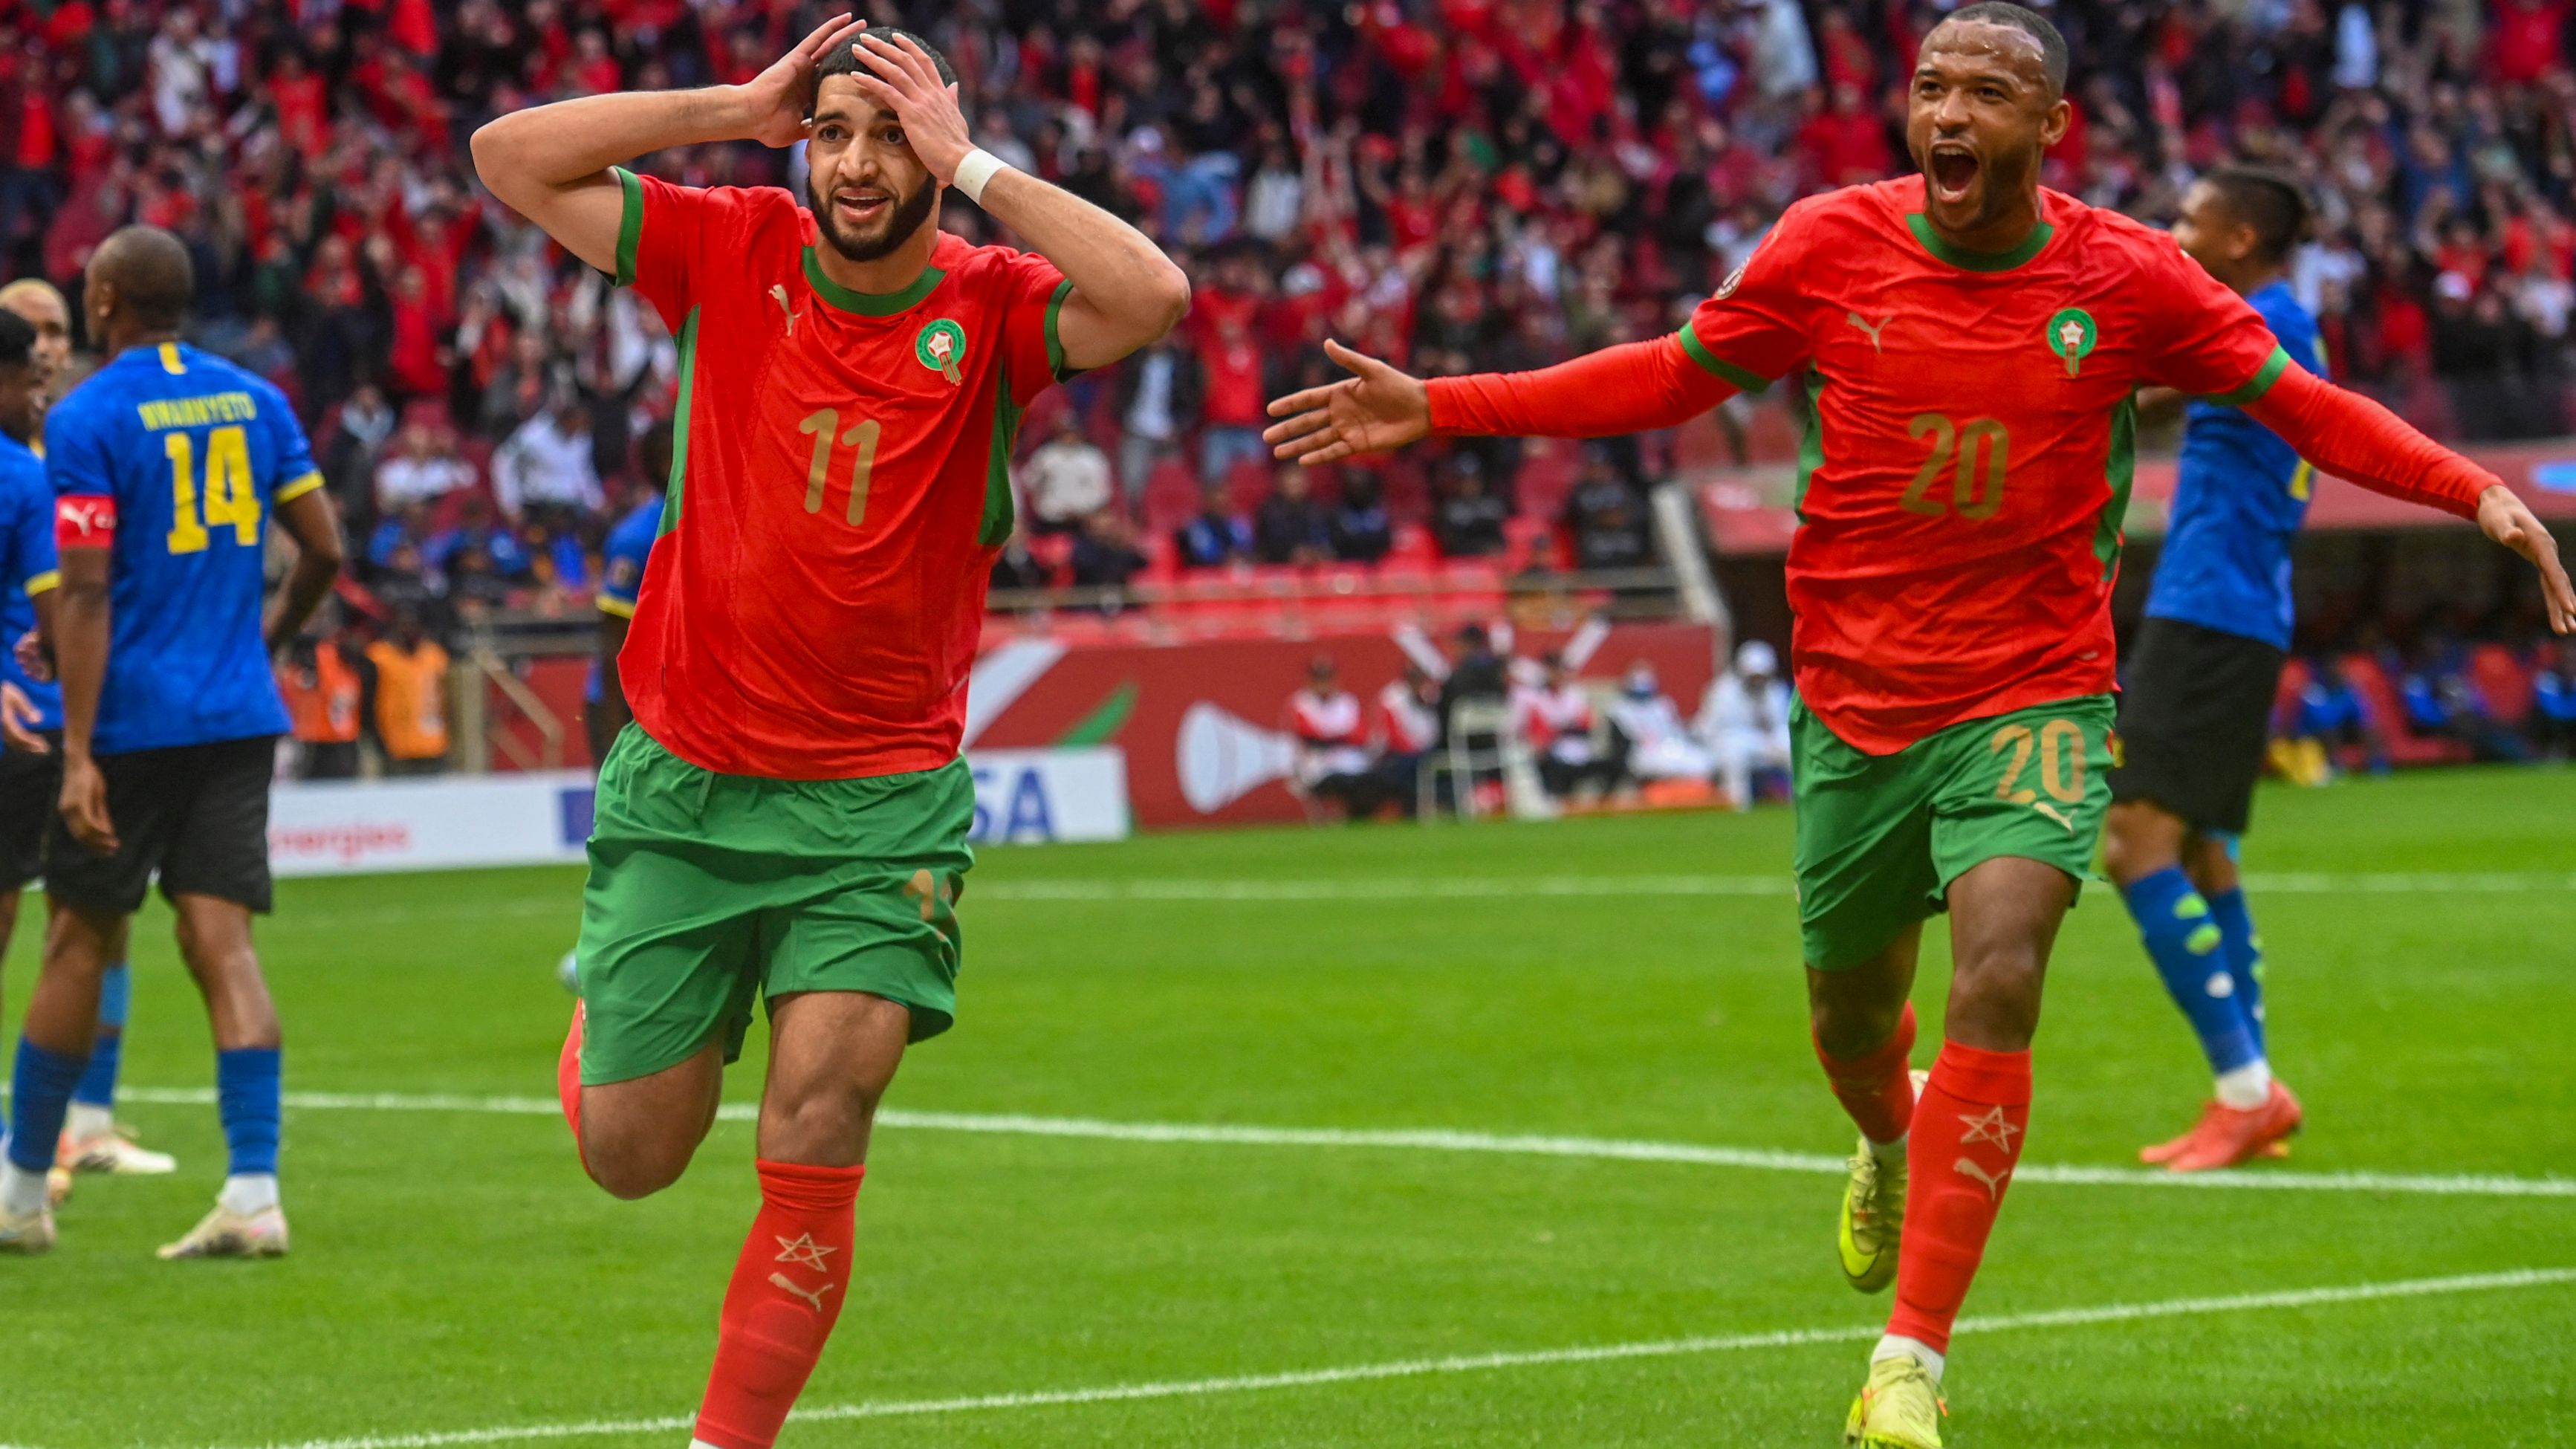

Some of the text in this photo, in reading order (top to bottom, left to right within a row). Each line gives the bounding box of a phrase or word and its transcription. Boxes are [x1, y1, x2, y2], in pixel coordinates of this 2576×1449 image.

[164, 424, 262, 555] 14
[799, 408, 880, 527] 11
[1898, 412, 2009, 519] 20
[1991, 719, 2086, 804] 20
